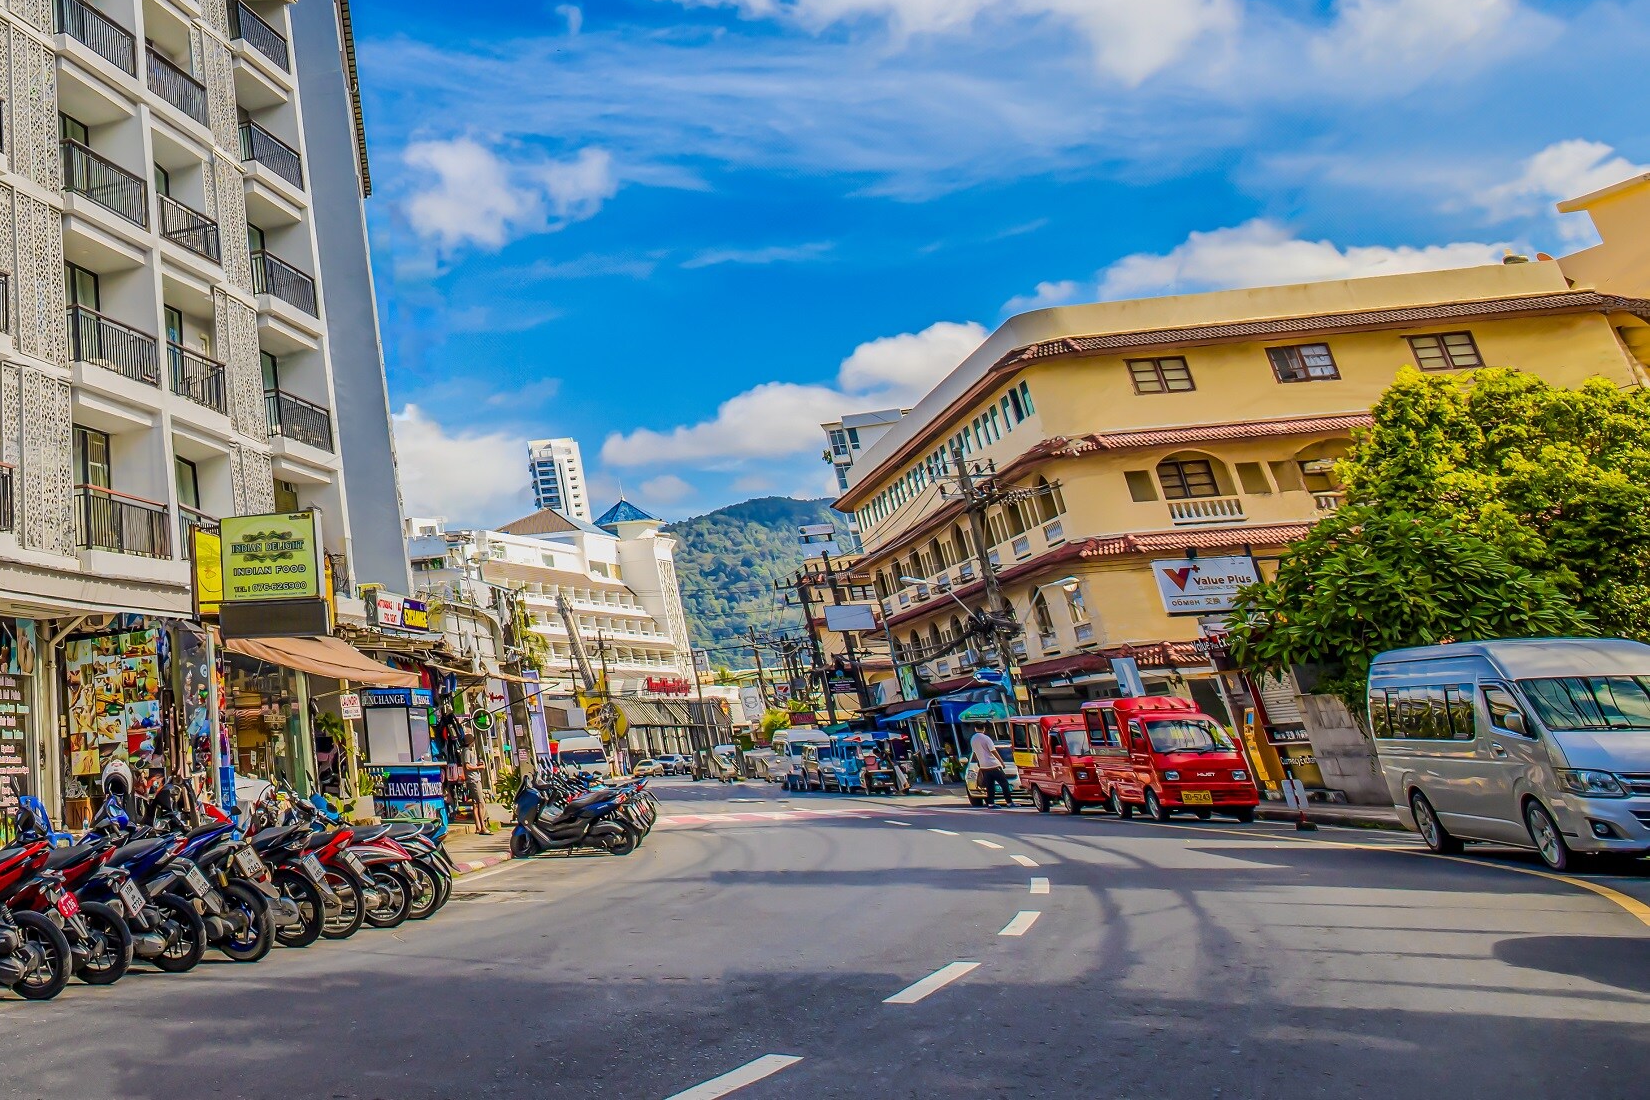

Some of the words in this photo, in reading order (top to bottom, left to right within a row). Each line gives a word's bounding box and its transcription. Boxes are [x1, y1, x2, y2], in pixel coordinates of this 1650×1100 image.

[231, 542, 262, 553] INDIAN
[265, 540, 304, 551] DELIGHT
[233, 565, 272, 576] INDIAN
[275, 564, 306, 574] FOOD
[1193, 577, 1224, 585] Value
[1227, 575, 1252, 584] Plus
